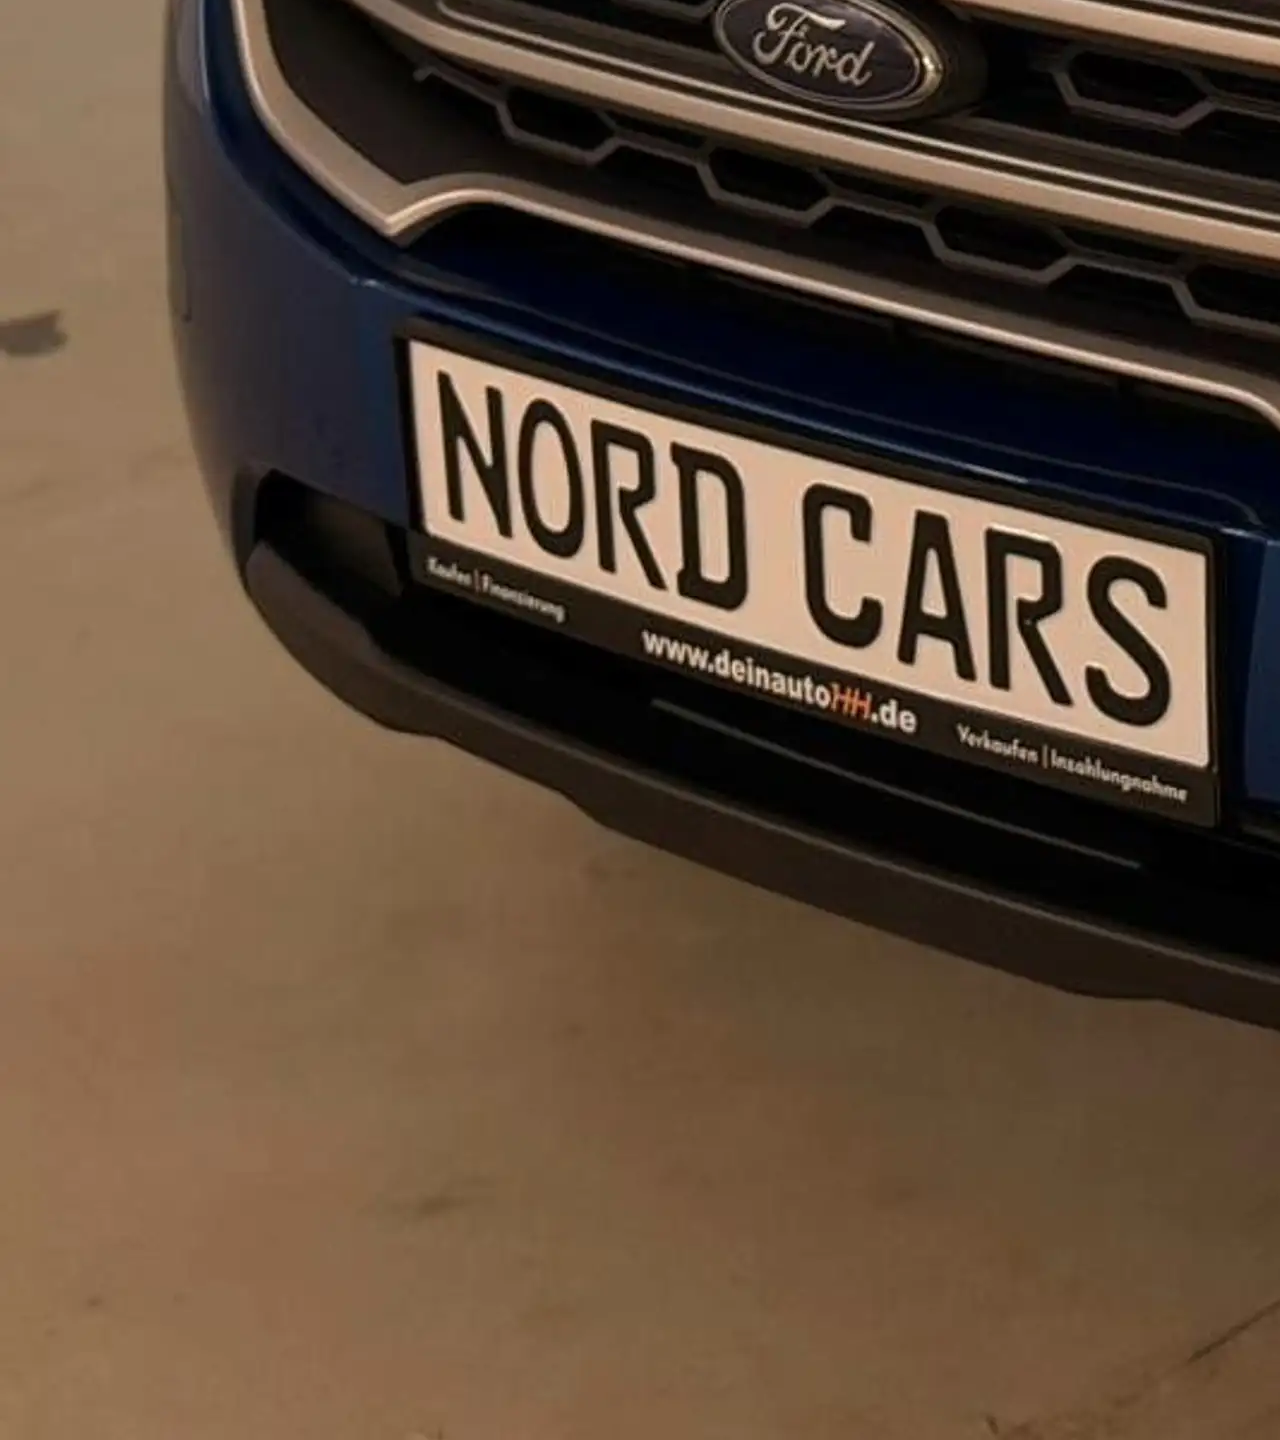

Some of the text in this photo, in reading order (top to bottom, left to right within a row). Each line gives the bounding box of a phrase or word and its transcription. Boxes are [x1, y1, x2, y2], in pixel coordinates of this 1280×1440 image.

[753, 3, 876, 87] Ford
[437, 370, 1171, 728] NORD CARS
[641, 629, 917, 733] www.deinautoHH.de
[956, 722, 1039, 764] Verkaufen
